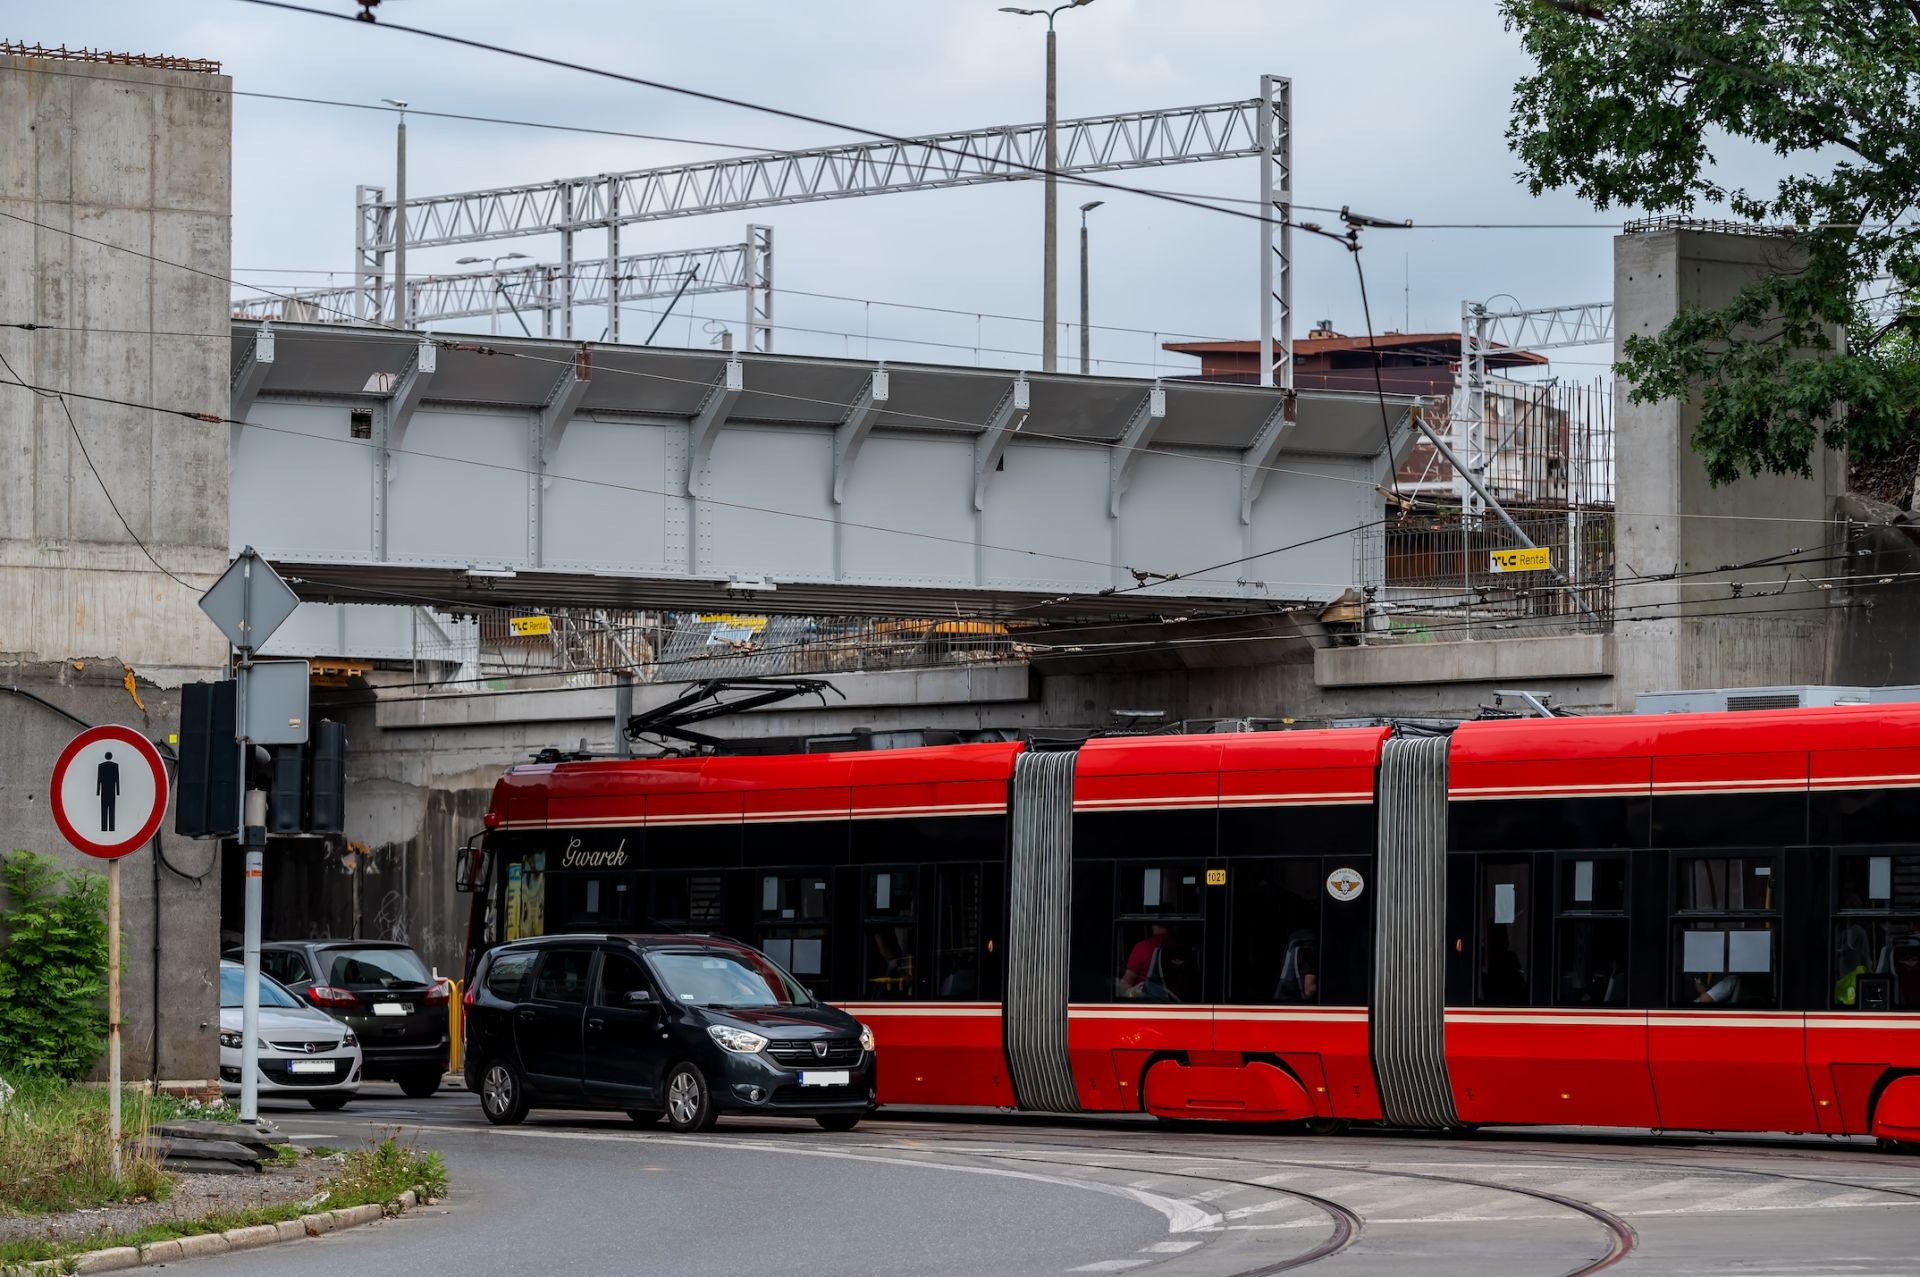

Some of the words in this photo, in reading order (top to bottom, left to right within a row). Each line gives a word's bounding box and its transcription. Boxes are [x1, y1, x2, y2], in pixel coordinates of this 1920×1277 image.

[1492, 555, 1517, 567] TLC
[1520, 554, 1548, 565] Rental
[511, 622, 528, 631] TLC
[562, 836, 628, 867] Gwarek
[1208, 872, 1225, 882] 1021
